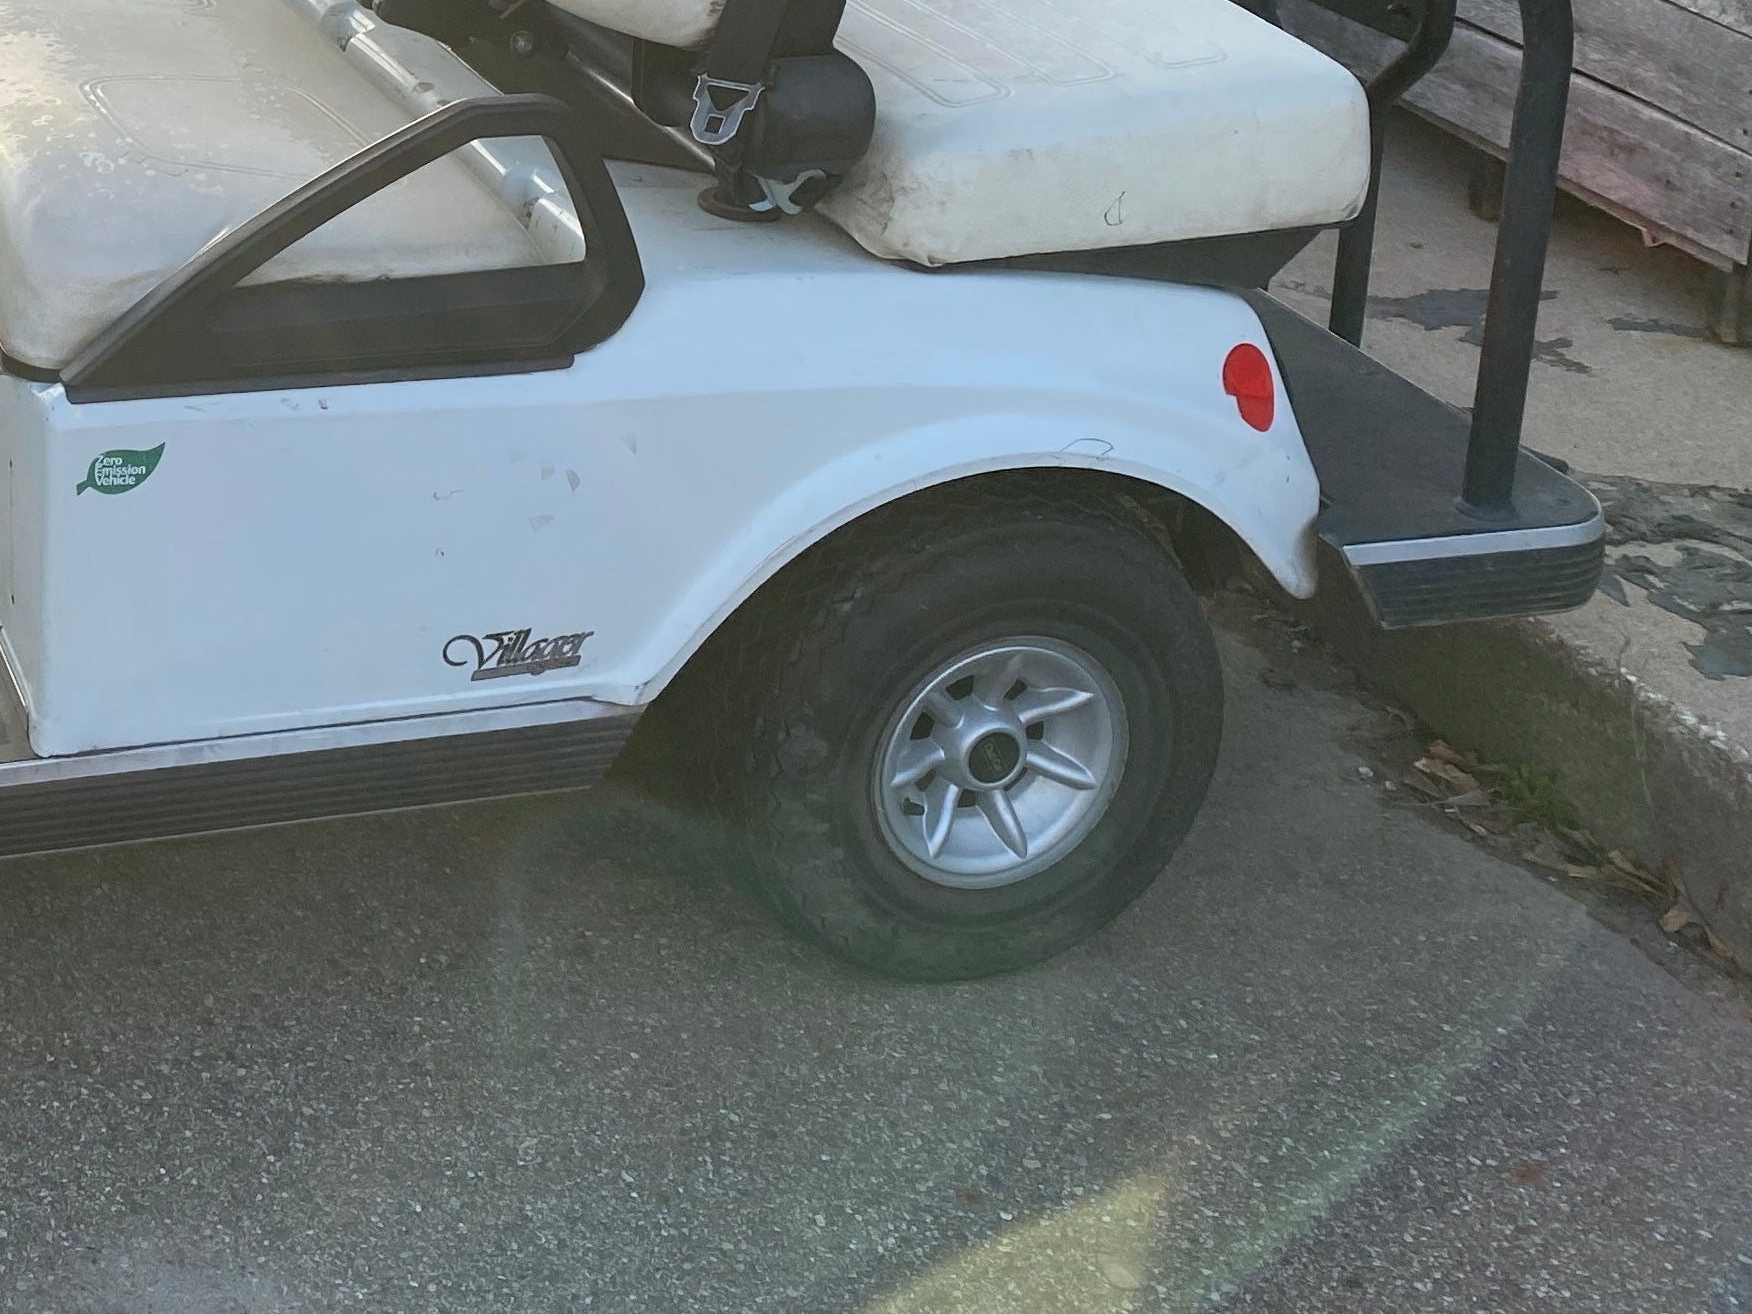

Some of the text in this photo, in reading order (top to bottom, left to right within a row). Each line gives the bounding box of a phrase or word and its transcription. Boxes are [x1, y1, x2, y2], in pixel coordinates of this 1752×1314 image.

[96, 455, 124, 466] Zero
[94, 464, 146, 477] Emission
[95, 474, 137, 486] Vehicle
